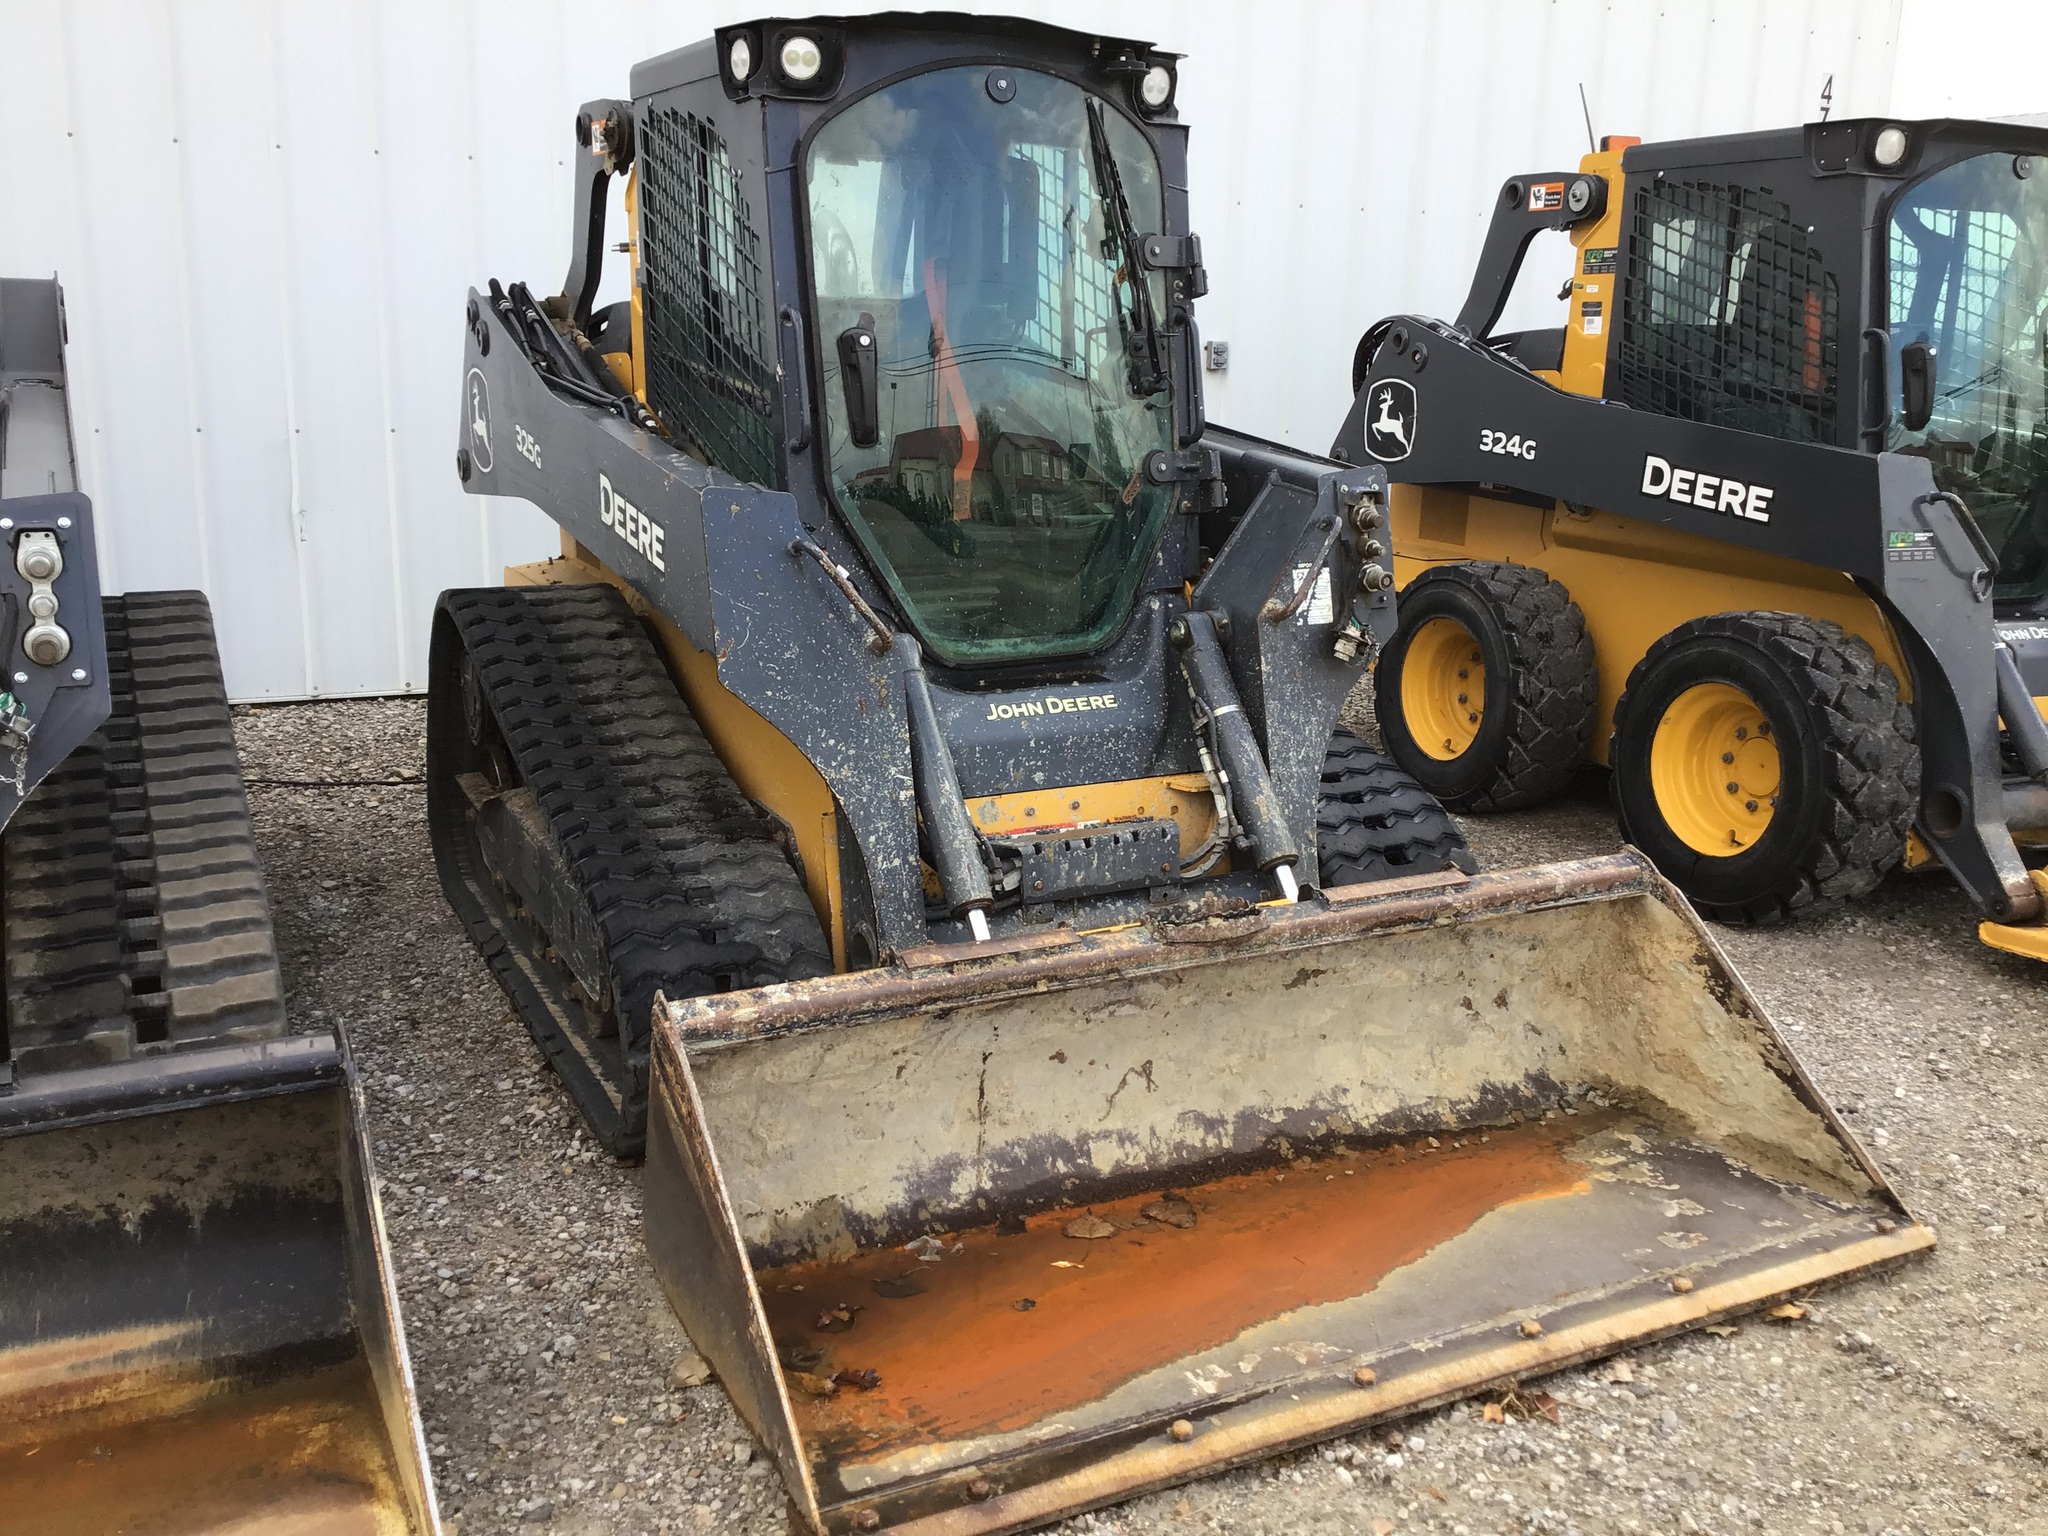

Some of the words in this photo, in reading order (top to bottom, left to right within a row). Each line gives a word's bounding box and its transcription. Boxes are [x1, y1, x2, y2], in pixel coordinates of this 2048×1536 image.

[515, 423, 543, 470] 325G
[1479, 429, 1537, 461] 324G
[1641, 455, 1774, 523] DEERE
[599, 473, 665, 573] DEERE
[986, 701, 1045, 721] JOHN
[1046, 695, 1117, 715] DEERE
